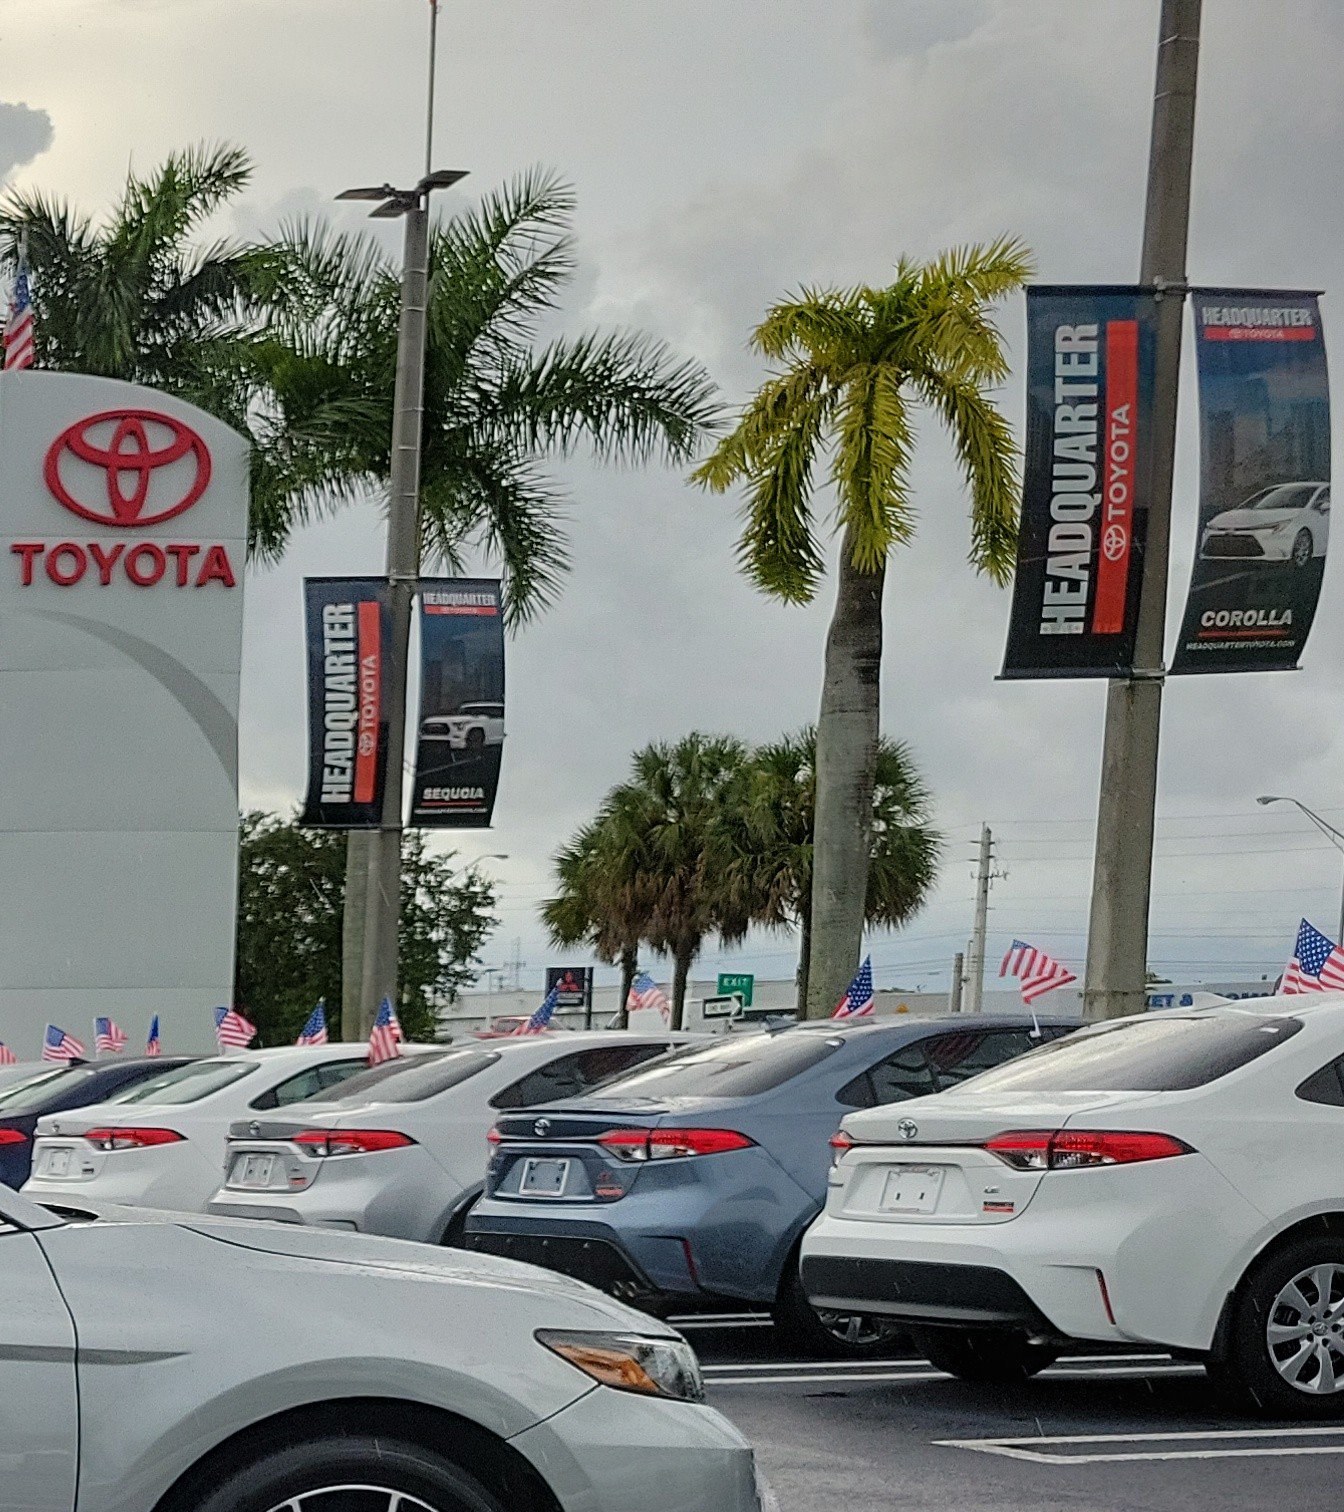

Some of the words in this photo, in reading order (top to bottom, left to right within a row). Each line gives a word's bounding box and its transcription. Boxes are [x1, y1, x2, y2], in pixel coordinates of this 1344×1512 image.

[1202, 307, 1312, 328] HEADQUARTER
[1039, 324, 1102, 635] HEADQUARTER
[1107, 404, 1131, 521] TOYOTA
[10, 542, 236, 588] TOYOTA
[1200, 609, 1293, 627] COROLLA
[320, 603, 358, 803] HEADQUARTER
[362, 655, 378, 731] TOYOTA
[422, 787, 485, 801] SEQUOIA
[723, 977, 749, 987] EXIT
